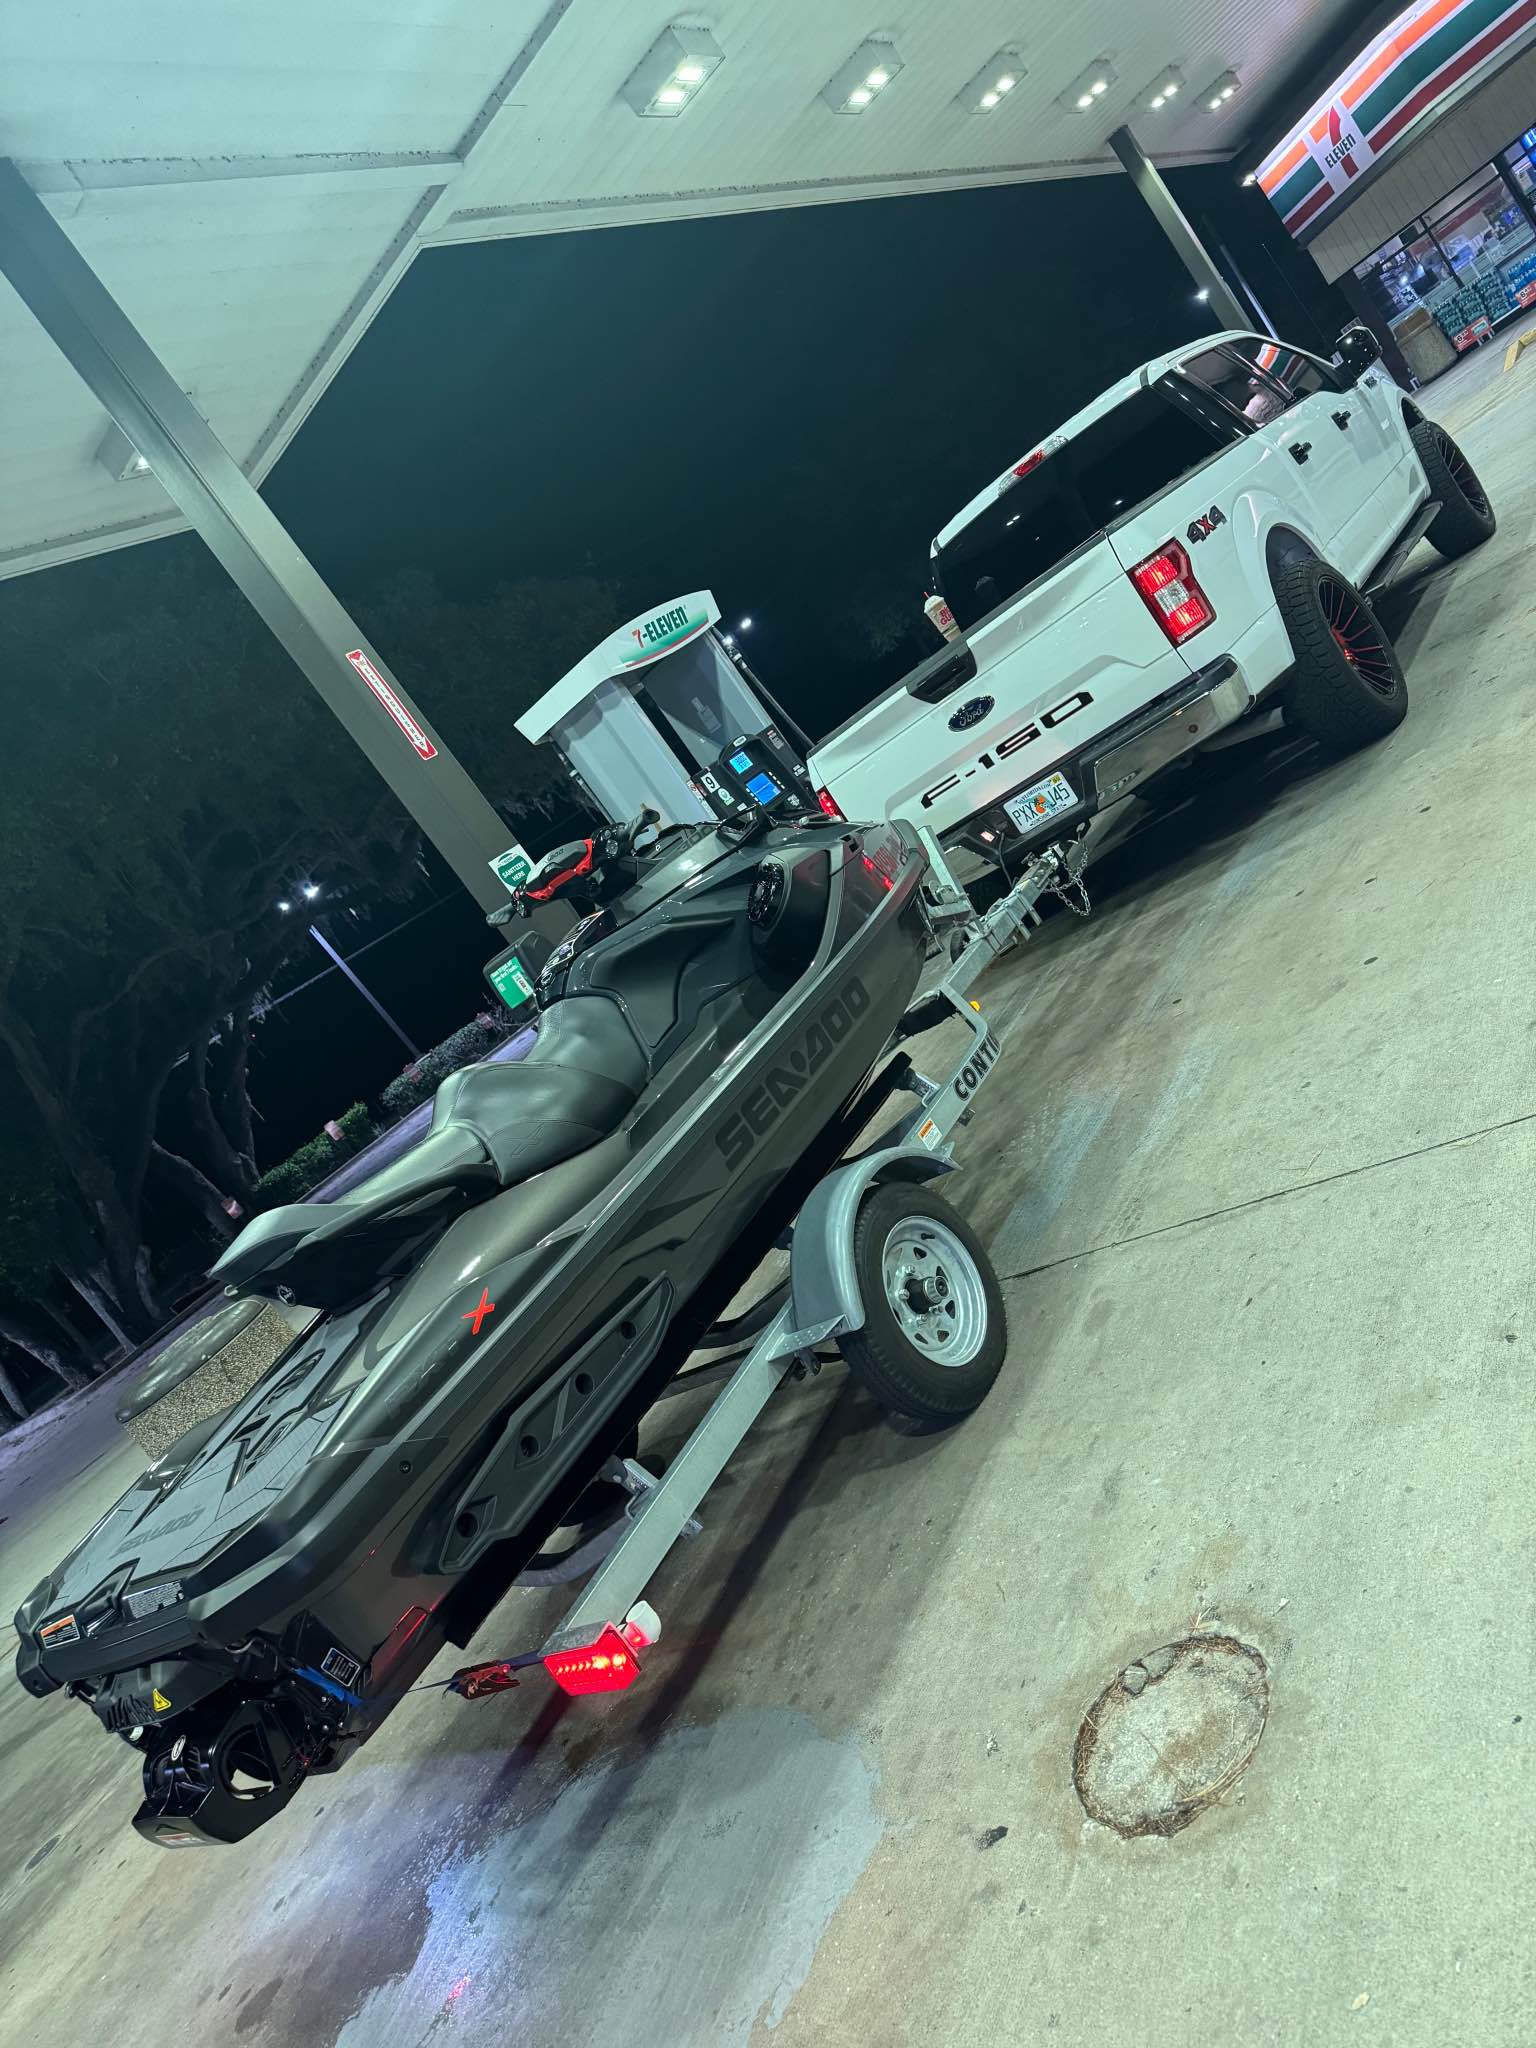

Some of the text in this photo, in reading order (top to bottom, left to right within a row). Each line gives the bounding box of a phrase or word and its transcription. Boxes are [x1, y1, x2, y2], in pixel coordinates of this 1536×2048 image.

[1325, 133, 1356, 168] ELEVEN
[632, 606, 689, 648] 7-ELEVEN
[921, 692, 1104, 809] F-150
[704, 776, 717, 790] 9
[1012, 782, 1071, 827] PXX J45
[501, 861, 527, 879] SANITIZER
[511, 870, 526, 882] HERE
